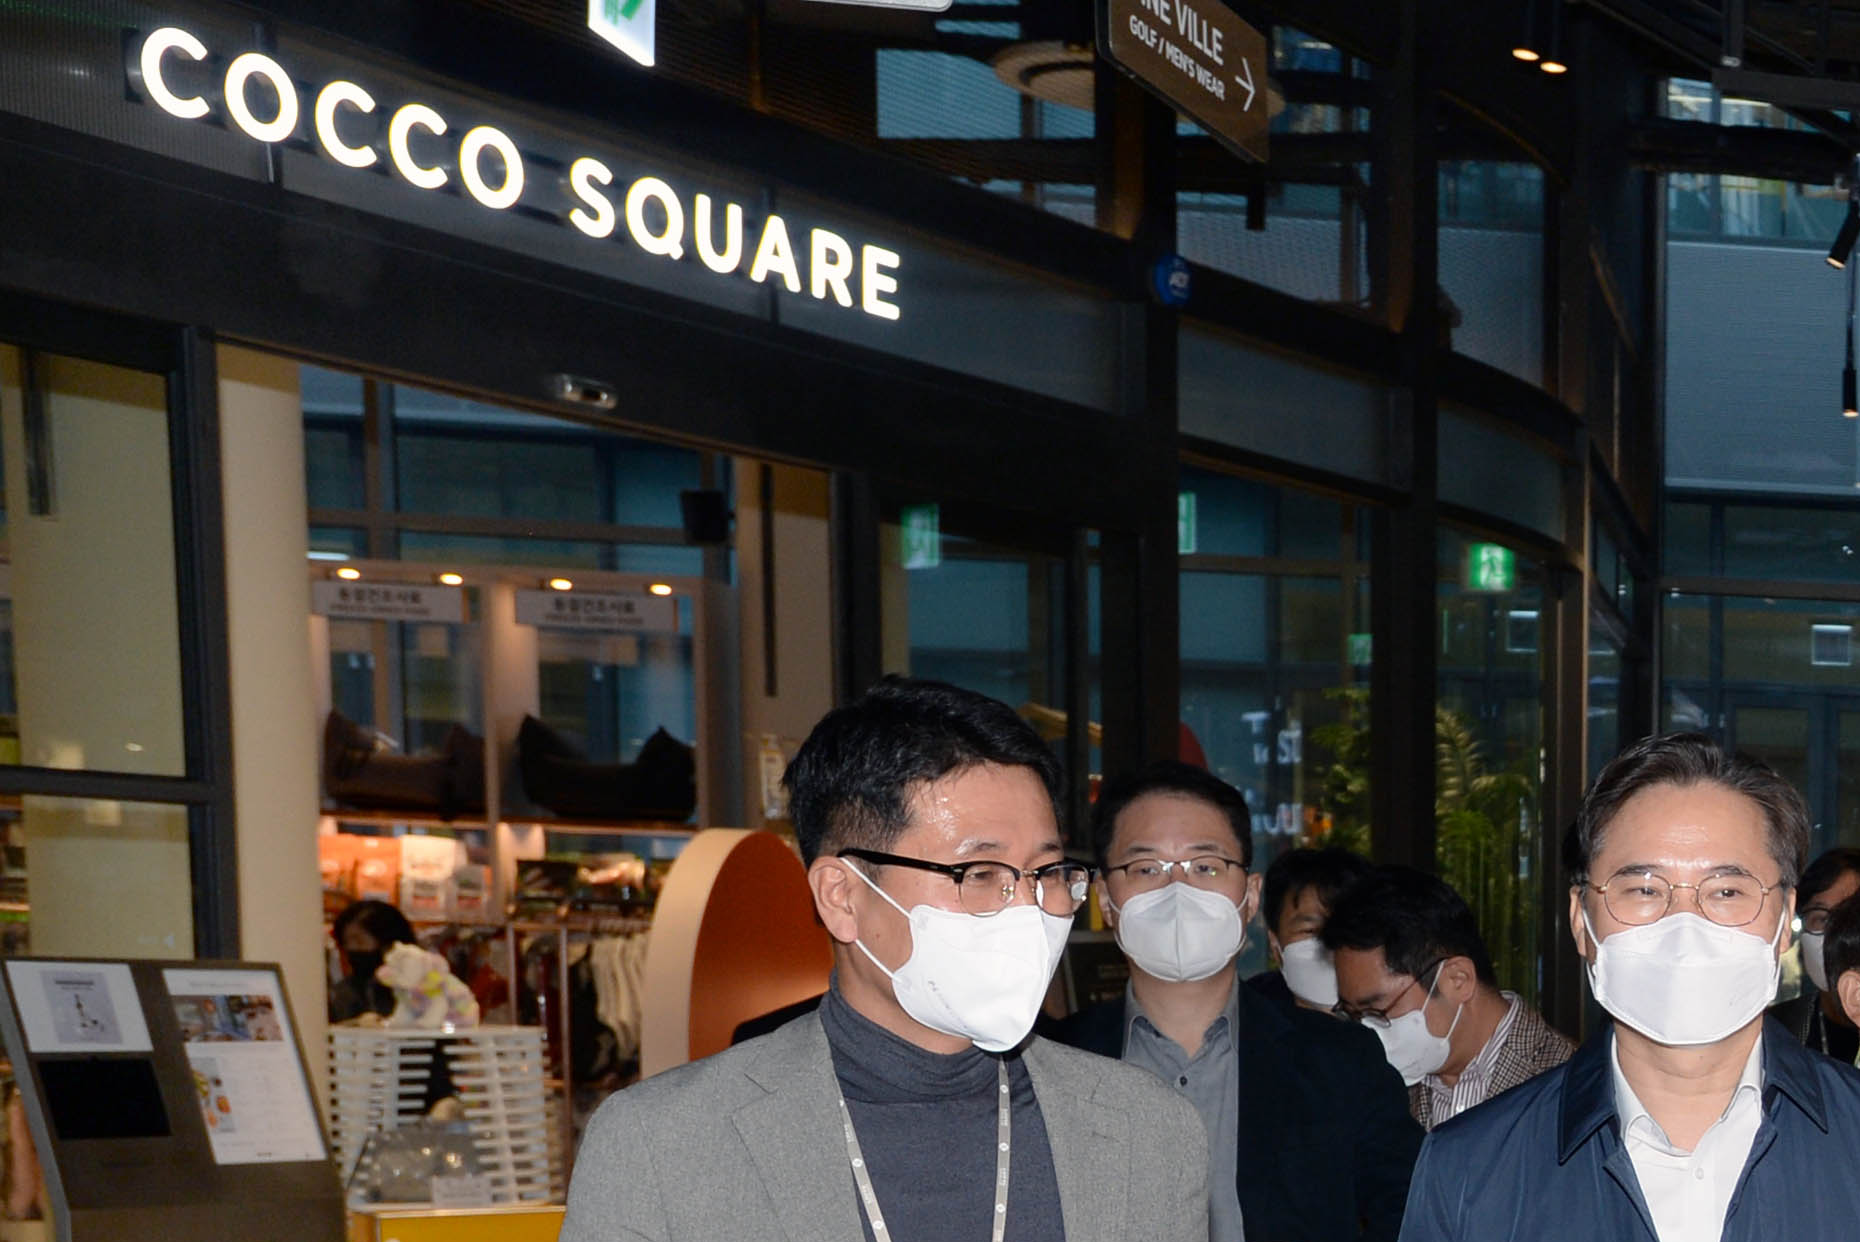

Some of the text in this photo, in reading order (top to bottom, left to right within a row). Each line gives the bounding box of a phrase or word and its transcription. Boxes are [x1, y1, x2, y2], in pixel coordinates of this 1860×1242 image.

[1129, 14, 1158, 48] GOLF
[1165, 41, 1195, 78] MEN'S
[1196, 63, 1225, 101] WEAR
[1174, 0, 1224, 66] VILLE
[140, 27, 902, 321] COCCO SQUARE
